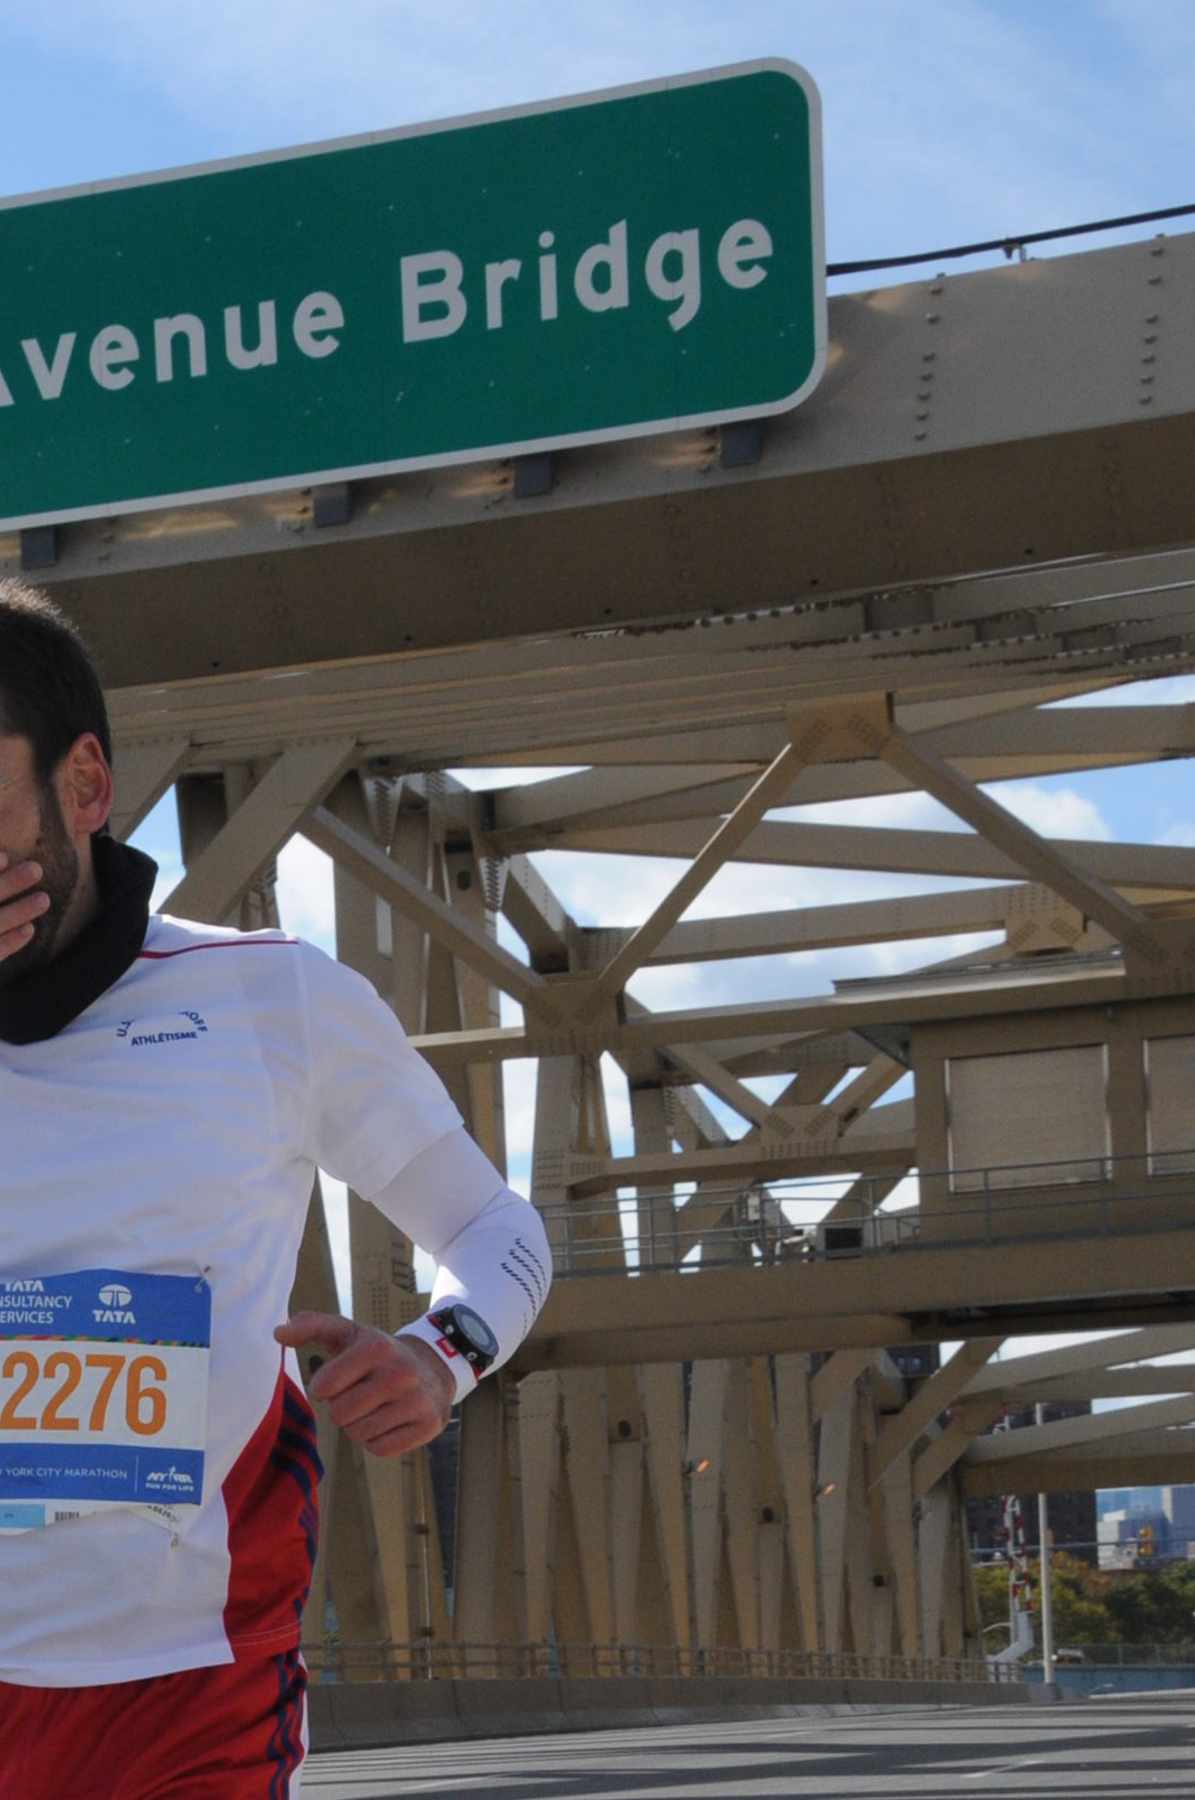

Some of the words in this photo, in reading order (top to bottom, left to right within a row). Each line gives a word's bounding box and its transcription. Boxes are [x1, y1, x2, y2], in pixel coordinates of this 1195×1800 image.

[401, 219, 773, 341] Bridge
[131, 1031, 197, 1046] ATHLÉTISME
[5, 1280, 44, 1292] TATA
[93, 1310, 136, 1324] TATA
[0, 1351, 167, 1435] 2276
[6, 1468, 34, 1477] YORK
[36, 1467, 61, 1477] CITY
[64, 1468, 127, 1479] MARATHON
